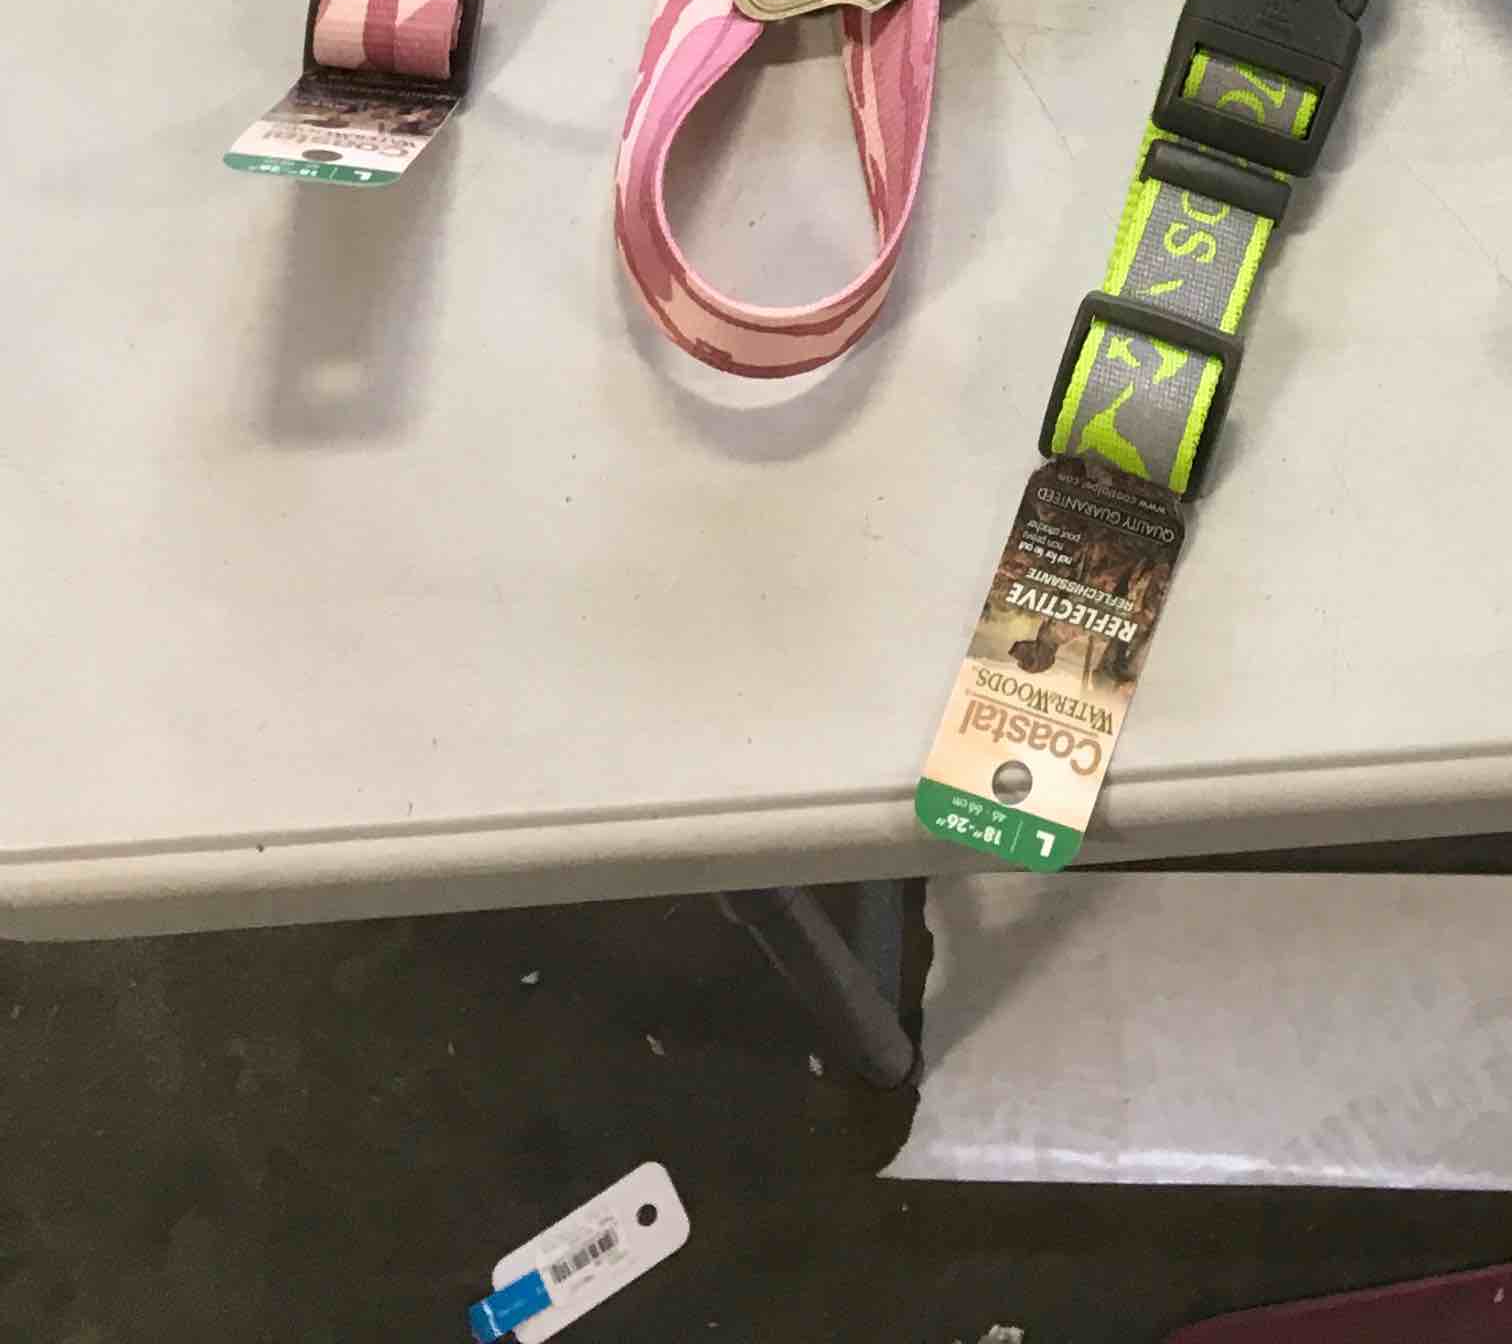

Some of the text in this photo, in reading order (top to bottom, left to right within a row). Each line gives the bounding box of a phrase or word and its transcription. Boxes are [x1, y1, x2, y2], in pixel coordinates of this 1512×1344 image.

[1034, 485, 1176, 544] QUALITY GUARANTEED
[1003, 579, 1138, 644] REFLECTIVE
[956, 697, 1105, 780] Coastal
[1030, 828, 1057, 858] L
